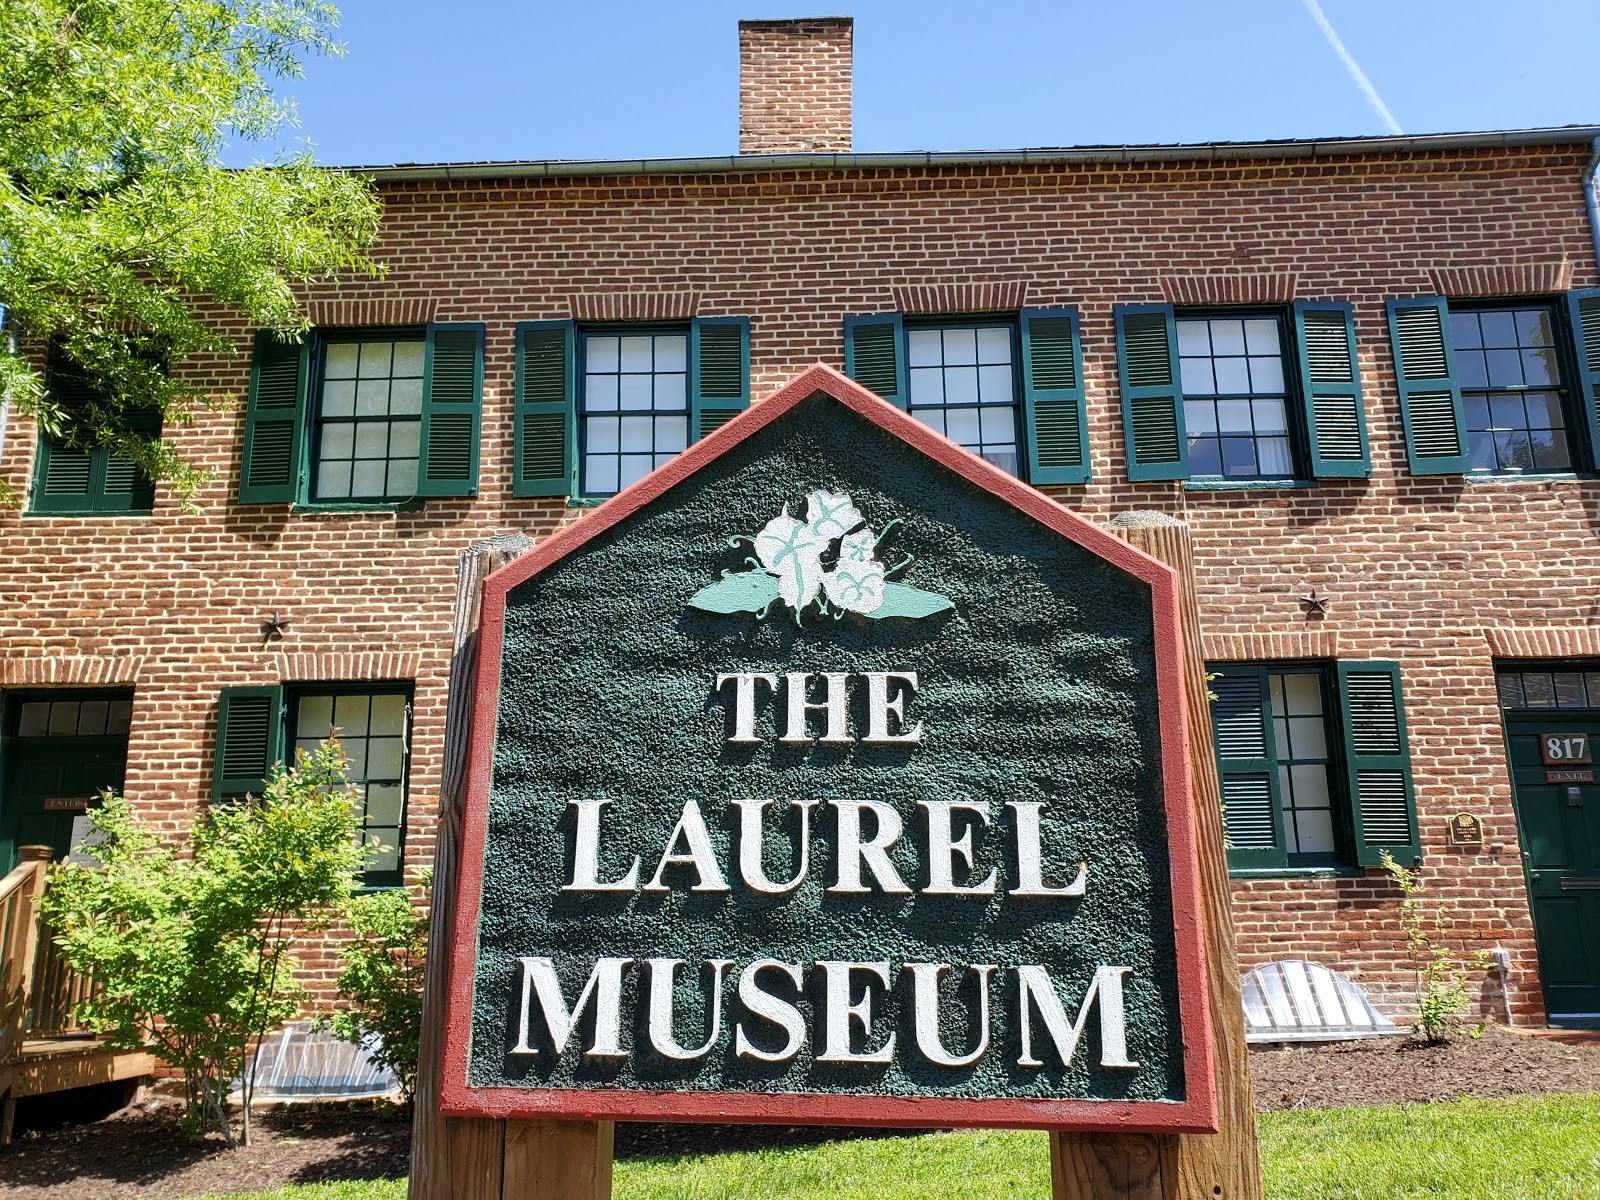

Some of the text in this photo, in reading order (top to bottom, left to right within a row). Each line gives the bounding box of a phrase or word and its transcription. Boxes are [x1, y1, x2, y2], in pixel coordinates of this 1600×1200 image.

[716, 671, 923, 743] THE
[1547, 737, 1586, 759] 817
[1557, 772, 1585, 780] EXIT
[562, 799, 1087, 896] LAUREL
[510, 957, 1139, 1067] MUSEUM
